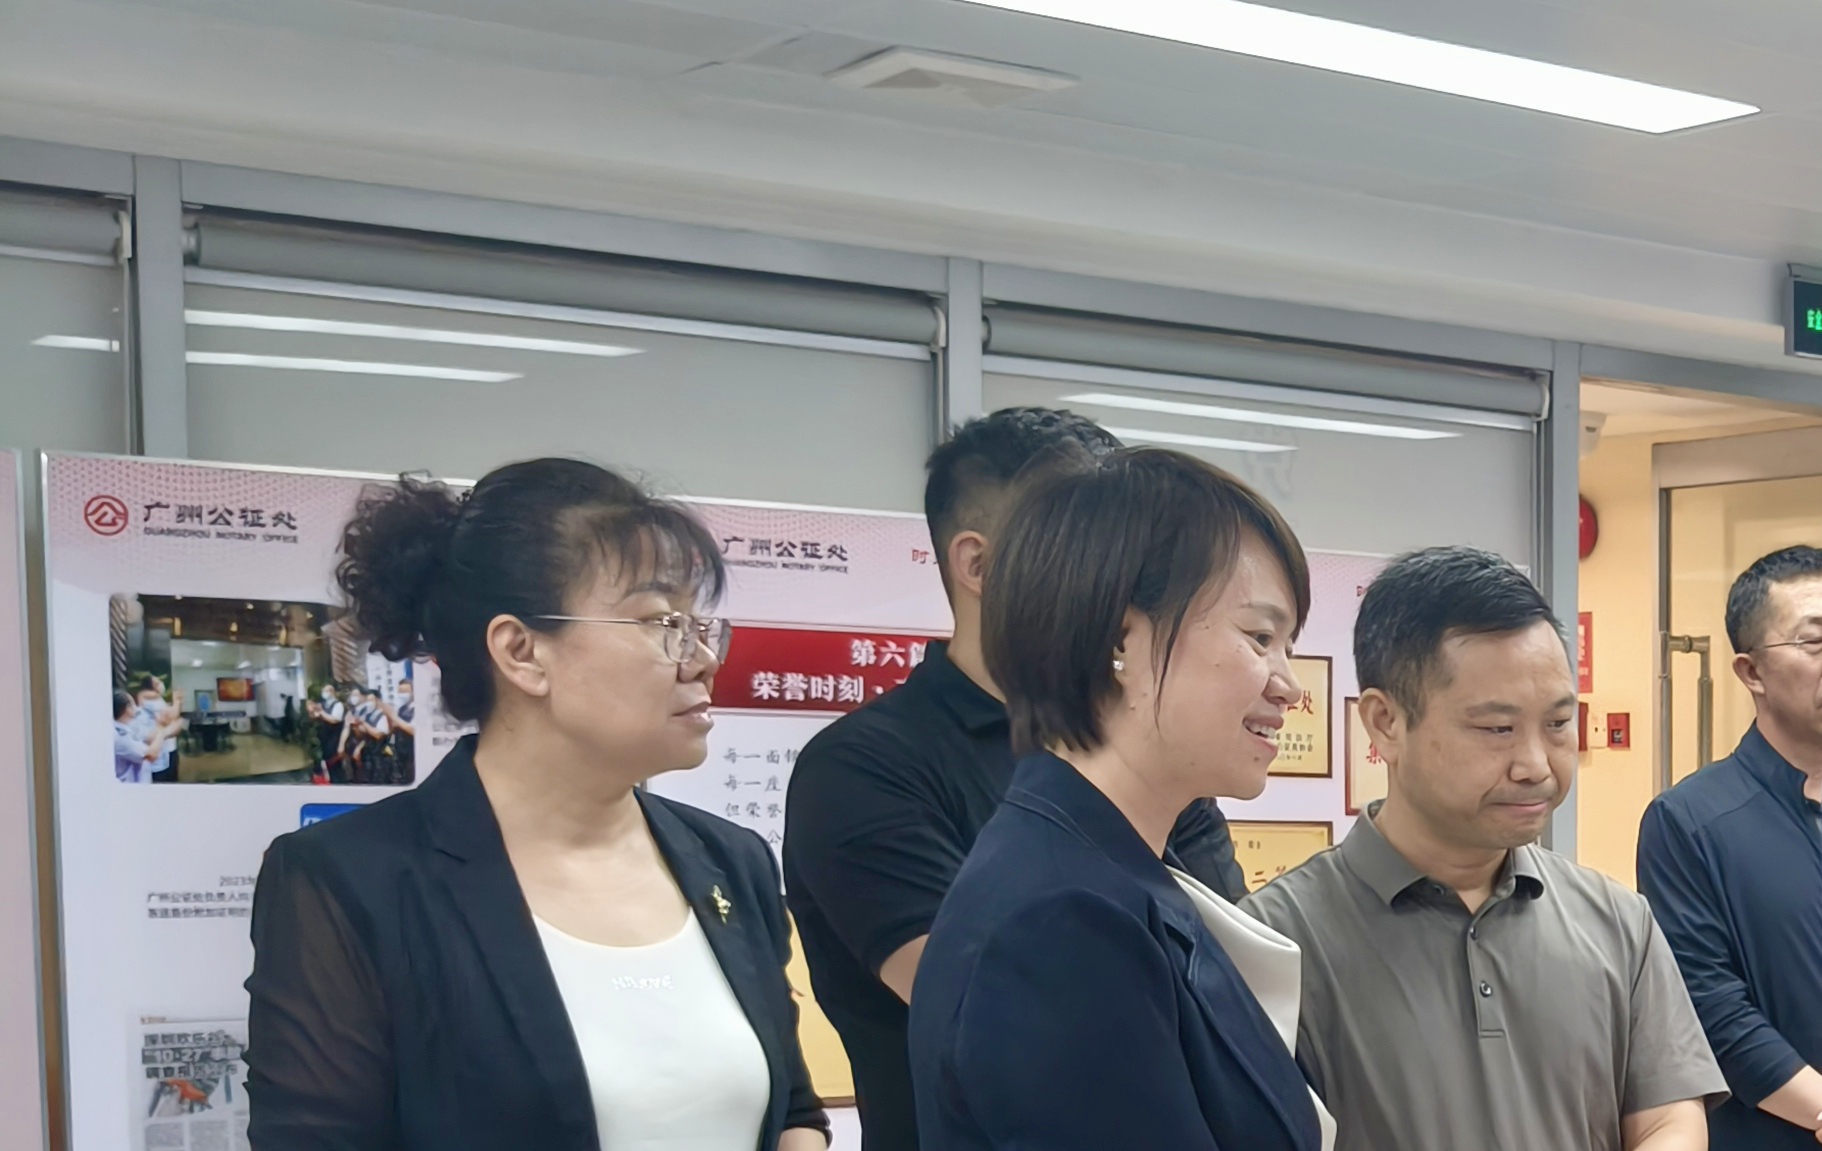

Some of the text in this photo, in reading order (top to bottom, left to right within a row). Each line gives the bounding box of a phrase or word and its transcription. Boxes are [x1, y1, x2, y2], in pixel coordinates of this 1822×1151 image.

[143, 501, 298, 531] 广州公证处
[722, 536, 849, 562] 广州公证处
